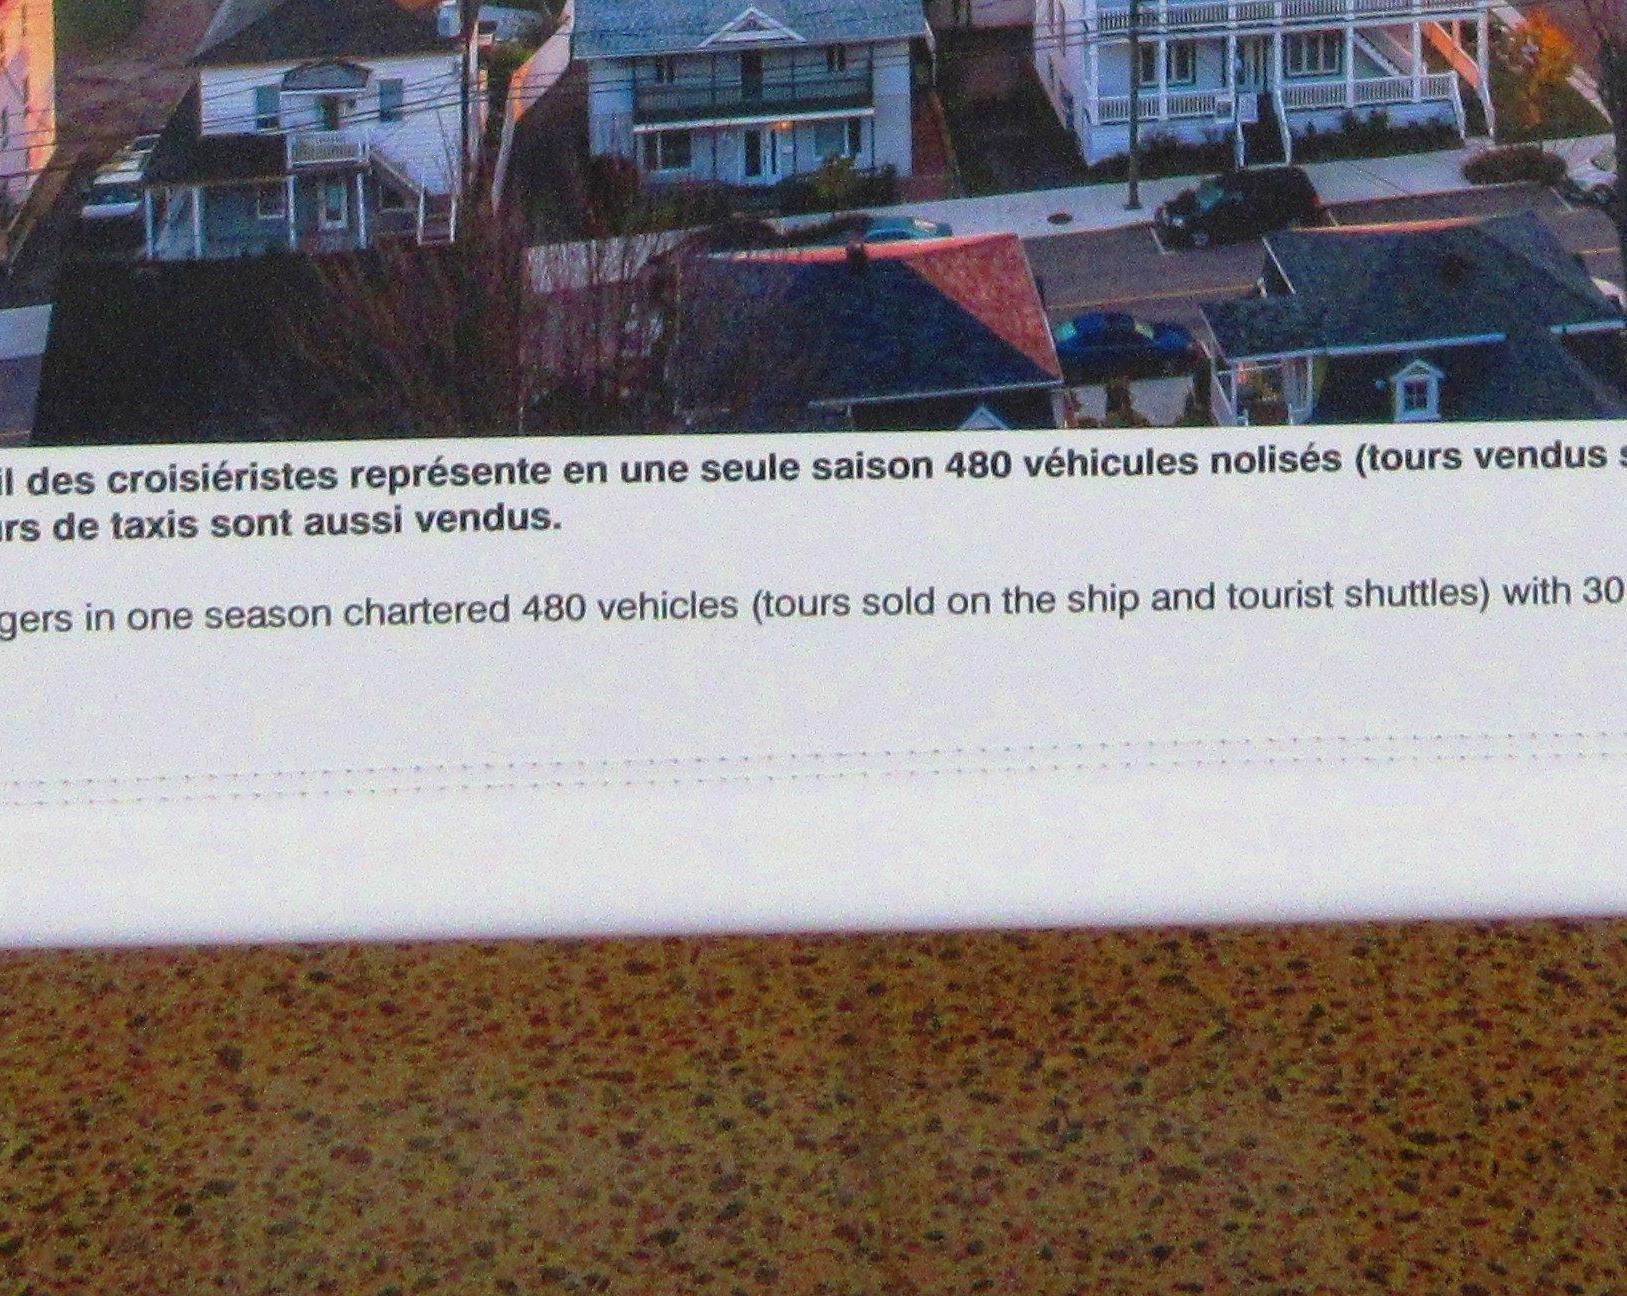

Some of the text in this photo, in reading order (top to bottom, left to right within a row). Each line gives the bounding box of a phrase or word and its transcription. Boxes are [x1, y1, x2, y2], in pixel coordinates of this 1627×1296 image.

[26, 466, 96, 497] des
[106, 459, 339, 495] croisiéristes
[350, 455, 552, 497] représente
[562, 460, 608, 485] en
[620, 459, 689, 485] une
[700, 452, 801, 484] seule
[812, 450, 934, 482] saison
[944, 449, 1013, 480] 480
[1022, 446, 1199, 479] véhicules
[1210, 441, 1343, 475] nolisés
[1354, 442, 1463, 480] (tours
[1473, 439, 1608, 470] vendus
[52, 511, 100, 542] de
[110, 508, 199, 541] taxis
[210, 508, 293, 539] sont
[303, 504, 403, 537] aussi
[414, 501, 562, 534] vendus.
[85, 602, 116, 632] in
[126, 607, 194, 632] one
[204, 604, 332, 630] season
[343, 593, 511, 627] chartered
[521, 593, 587, 623] 480
[597, 590, 739, 622] vehicles
[752, 589, 851, 626] (tours
[862, 585, 935, 617] sold
[947, 591, 991, 616] on
[1001, 584, 1057, 615] the
[1067, 582, 1140, 620] ship
[1150, 581, 1216, 612] and
[1226, 579, 1334, 611] tourist
[1344, 577, 1490, 614] shuttles)
[1502, 575, 1572, 606] with
[1582, 575, 1625, 605] 30
